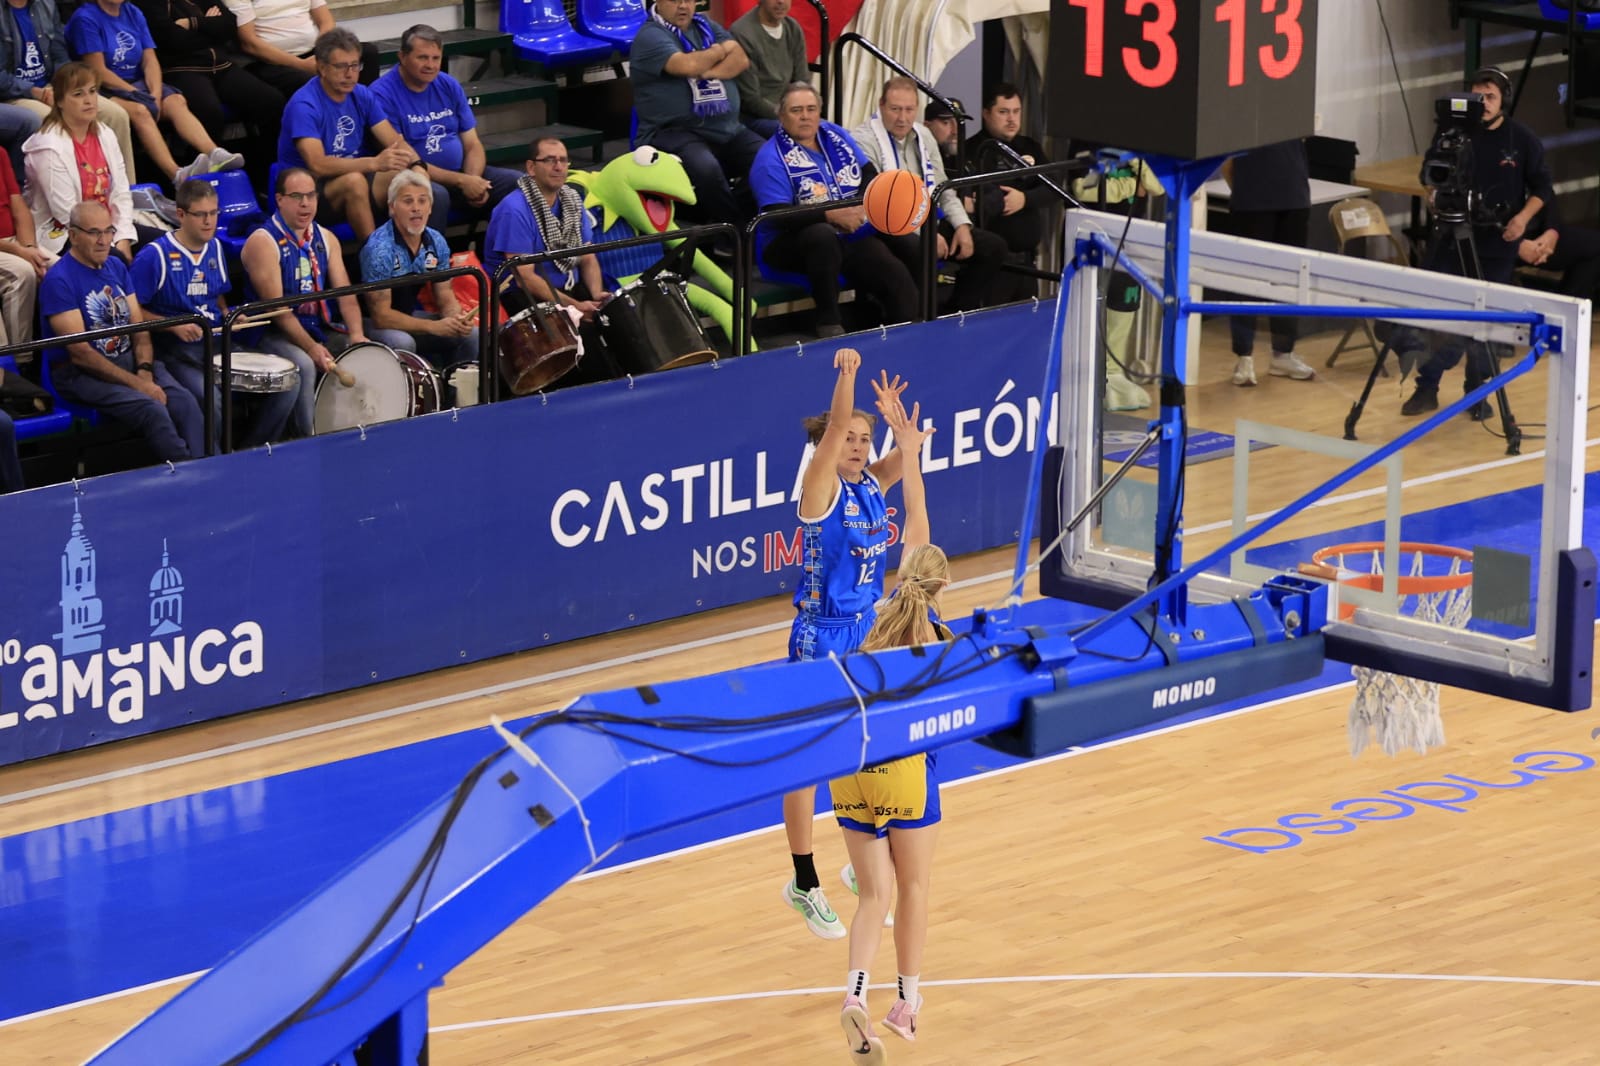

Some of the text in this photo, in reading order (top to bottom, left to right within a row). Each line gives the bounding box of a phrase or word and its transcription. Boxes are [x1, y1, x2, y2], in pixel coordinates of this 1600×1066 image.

[1069, 0, 1178, 88] 13
[1215, 0, 1303, 87] 13
[921, 378, 1059, 474] LEÓN
[692, 536, 757, 579] NOS
[857, 559, 877, 586] 12
[909, 705, 977, 742] MONDO
[1152, 677, 1216, 709] MONDO
[1201, 750, 1596, 854] endesa
